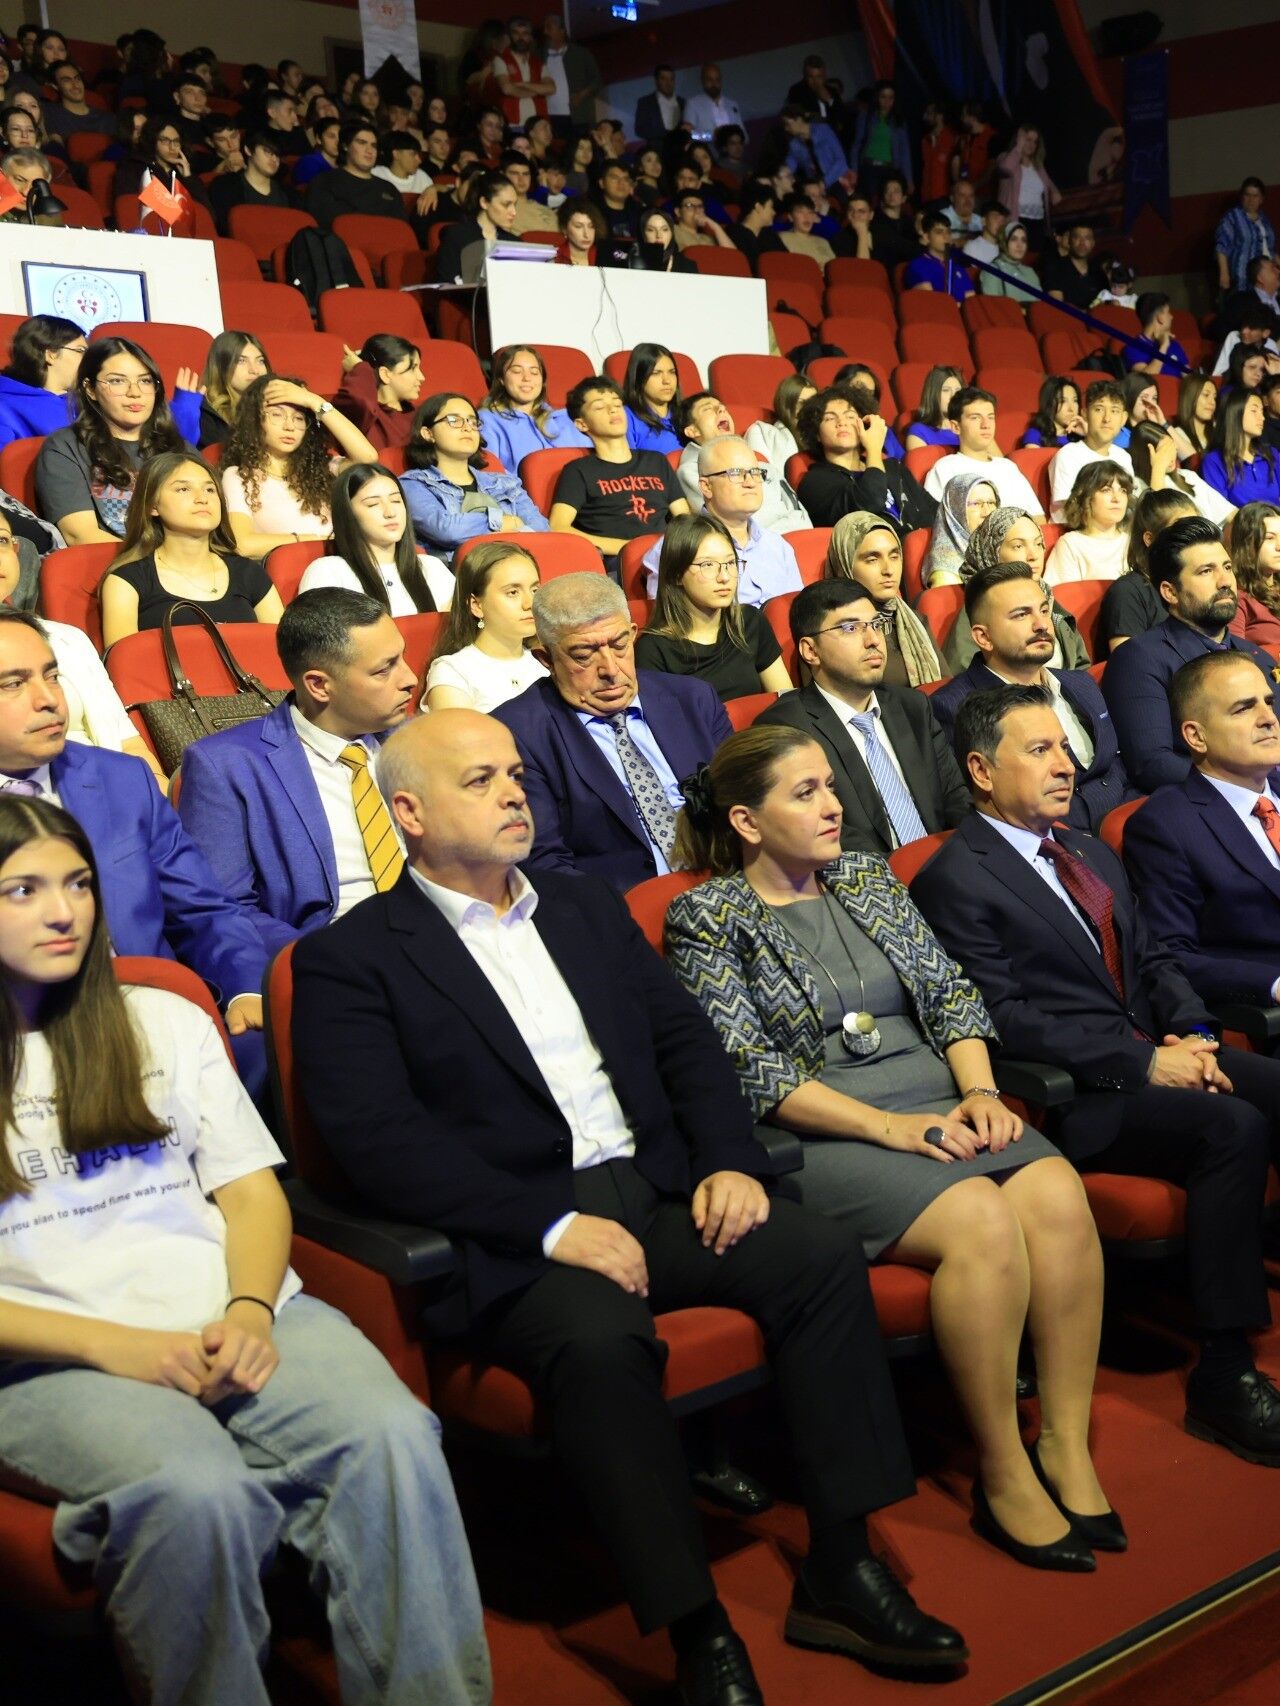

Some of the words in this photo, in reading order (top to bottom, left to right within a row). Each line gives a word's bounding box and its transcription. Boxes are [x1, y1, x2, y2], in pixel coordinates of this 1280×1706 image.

[596, 475, 665, 496] ROCKETS
[57, 1210, 69, 1218] to
[72, 1199, 107, 1217] spend
